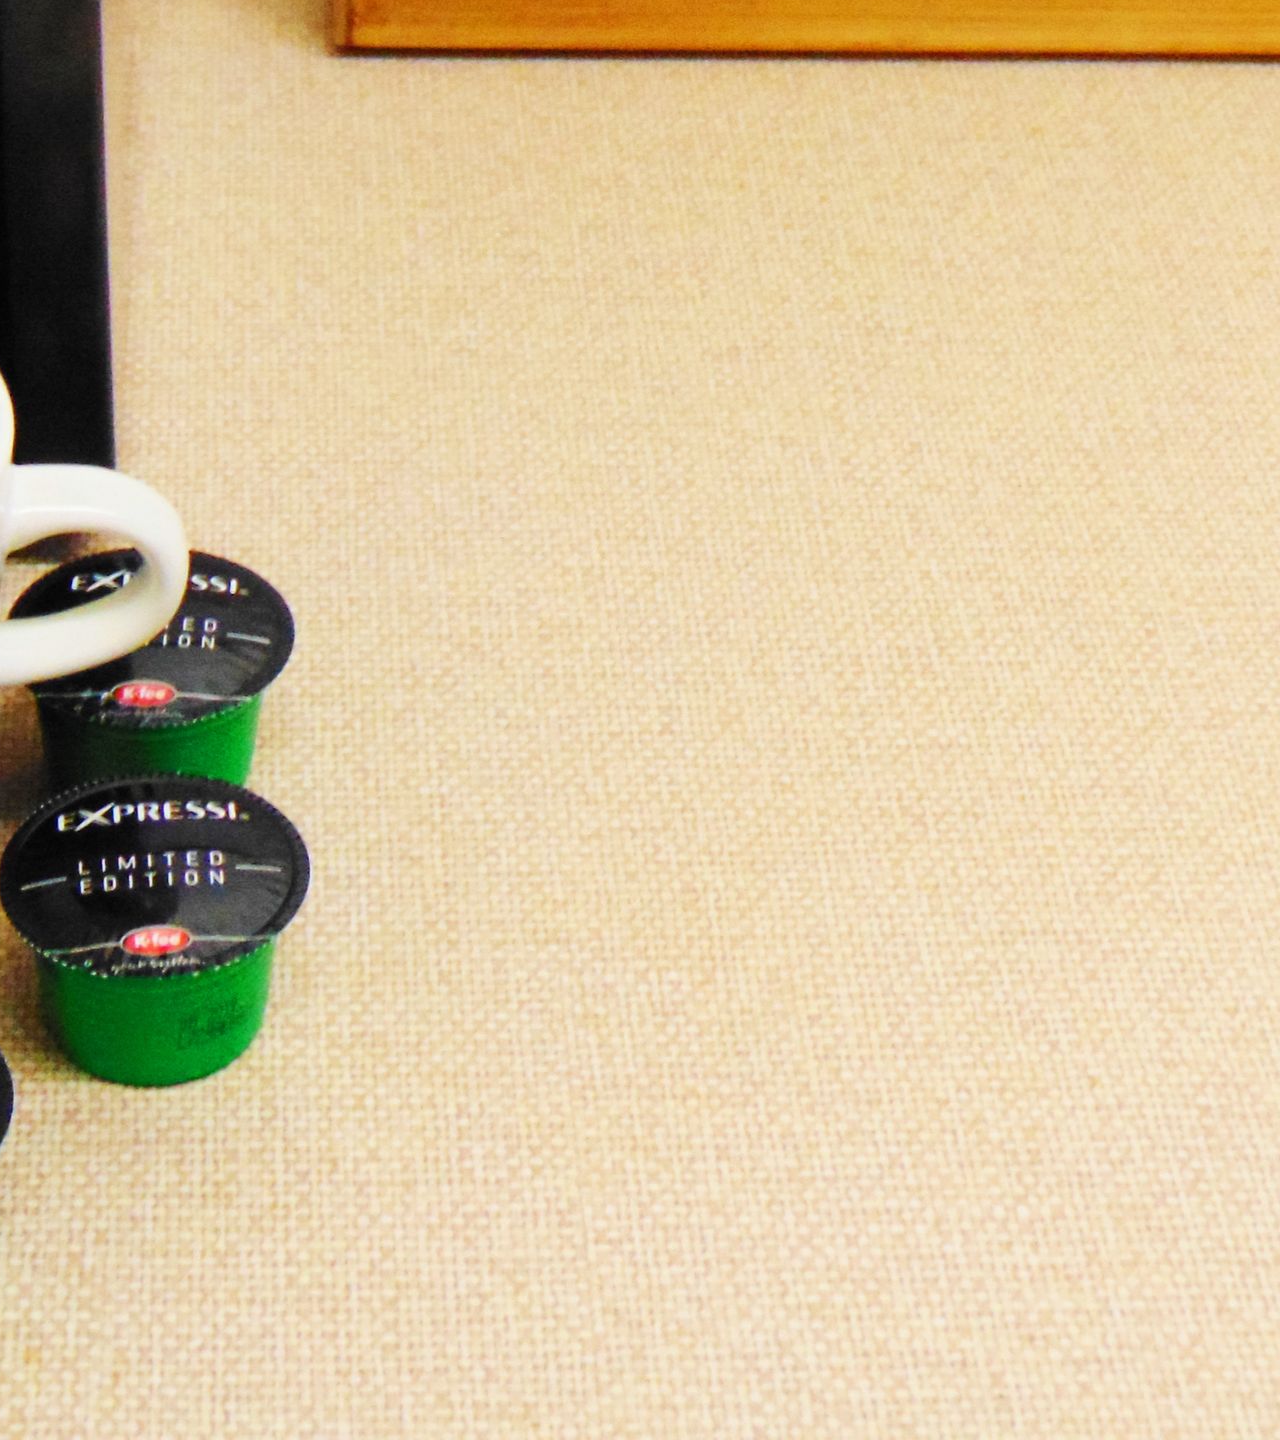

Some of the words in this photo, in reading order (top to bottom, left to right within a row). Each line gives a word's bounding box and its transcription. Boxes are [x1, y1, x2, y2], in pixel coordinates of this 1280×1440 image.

[56, 801, 242, 834] EXPRESSI
[77, 849, 226, 877] LIMITED
[79, 870, 227, 896] EDITION
